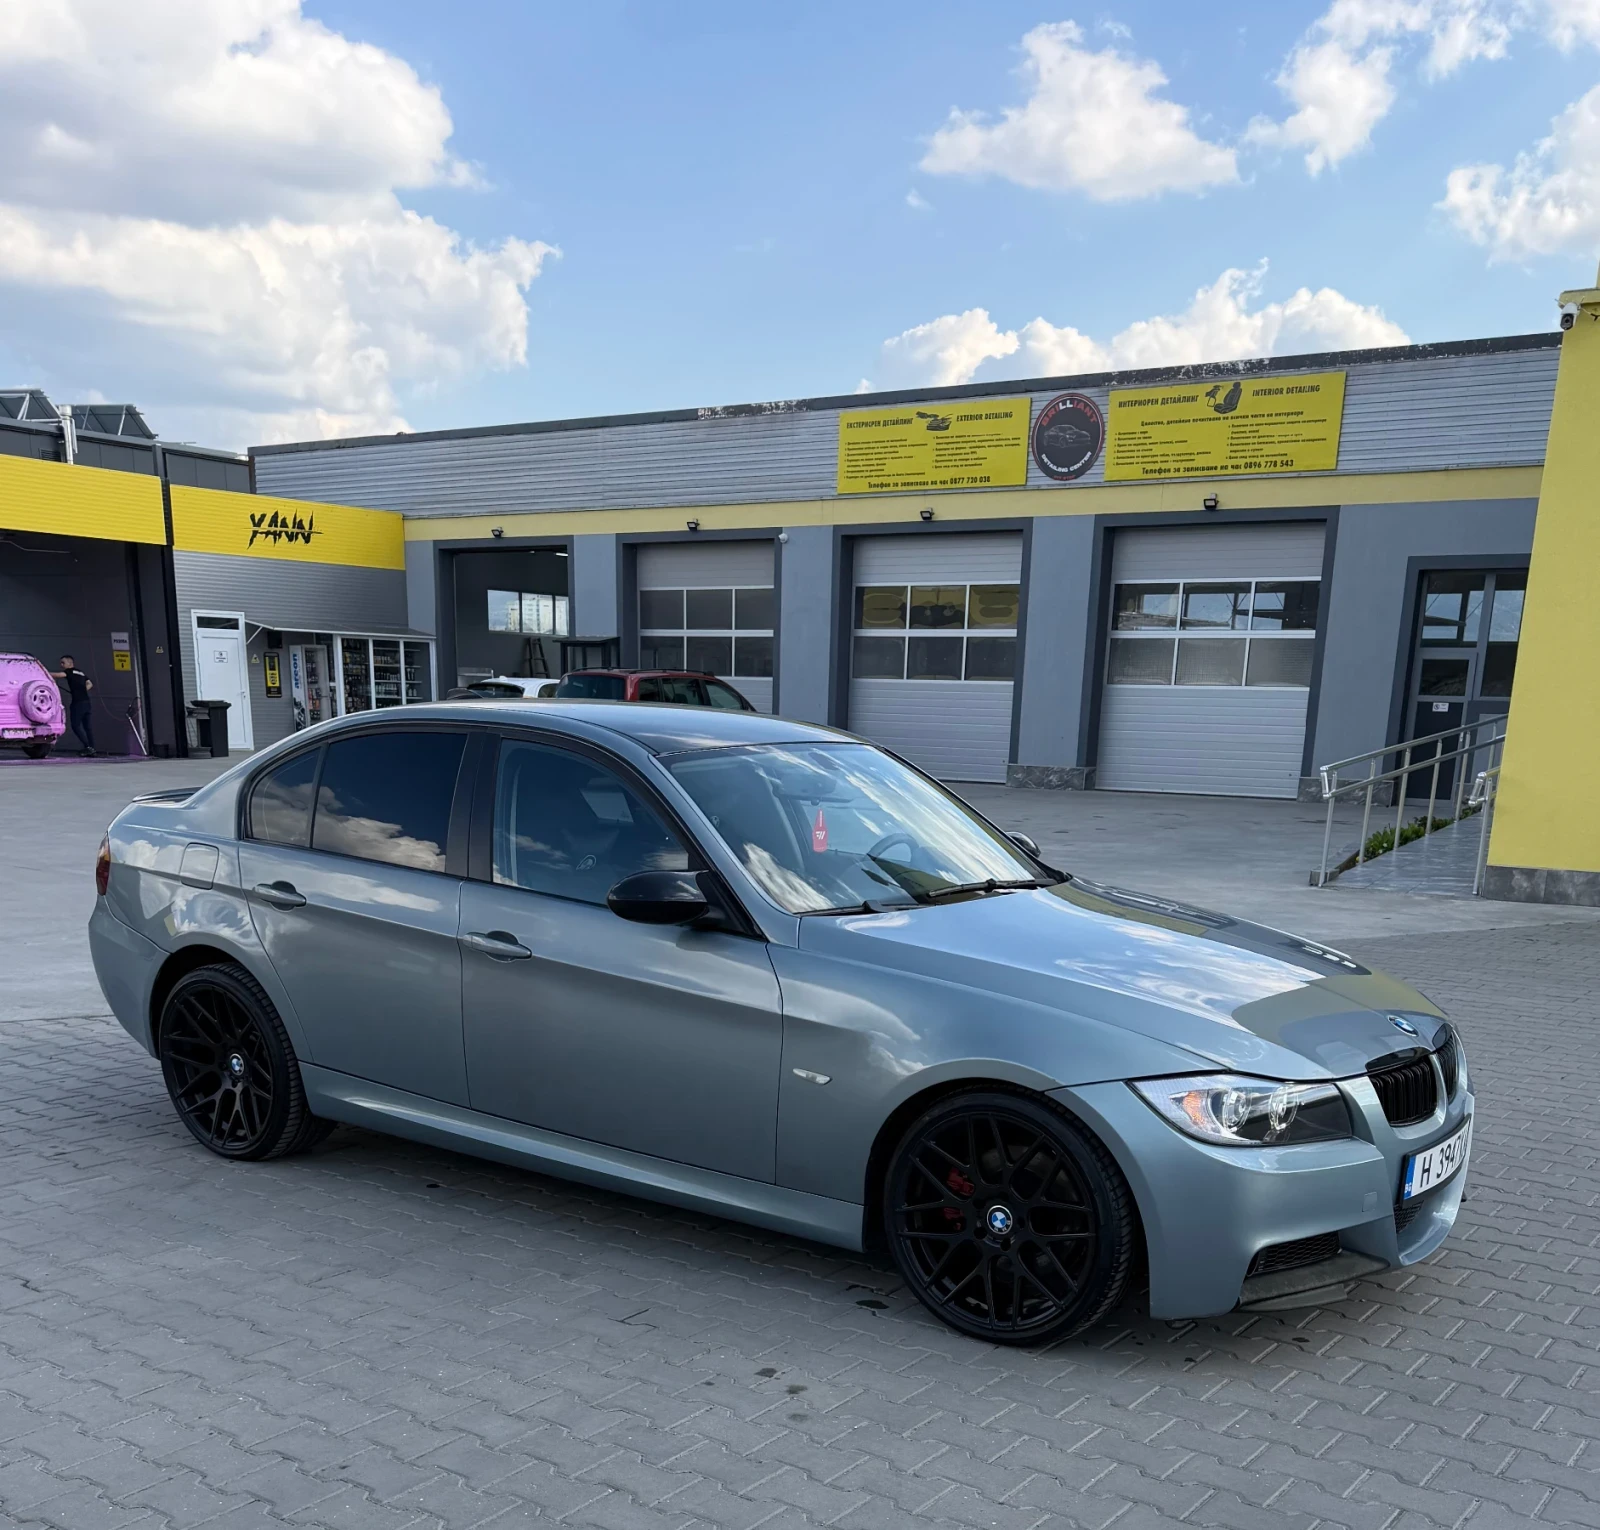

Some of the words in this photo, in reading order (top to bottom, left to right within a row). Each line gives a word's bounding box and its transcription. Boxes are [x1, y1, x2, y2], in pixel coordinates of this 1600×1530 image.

[1252, 387, 1284, 397] INTERIOR
[1285, 384, 1321, 395] DETAILING
[1118, 398, 1159, 408] ИНТЕРИОРЕН
[1160, 394, 1200, 406] ДЕТАЙЛИНГ
[956, 413, 983, 422] EXTERIOR
[984, 411, 1014, 420] DETAILING
[1041, 400, 1097, 426] BRILLIANT
[1041, 453, 1069, 473] DETAILING
[1141, 467, 1171, 475] Телефон
[1182, 465, 1218, 473] записване
[1243, 461, 1262, 470] 0896
[1263, 460, 1278, 469] 778
[1279, 459, 1294, 468] 543
[246, 508, 315, 550] YANN
[1420, 1153, 1433, 1188] H
